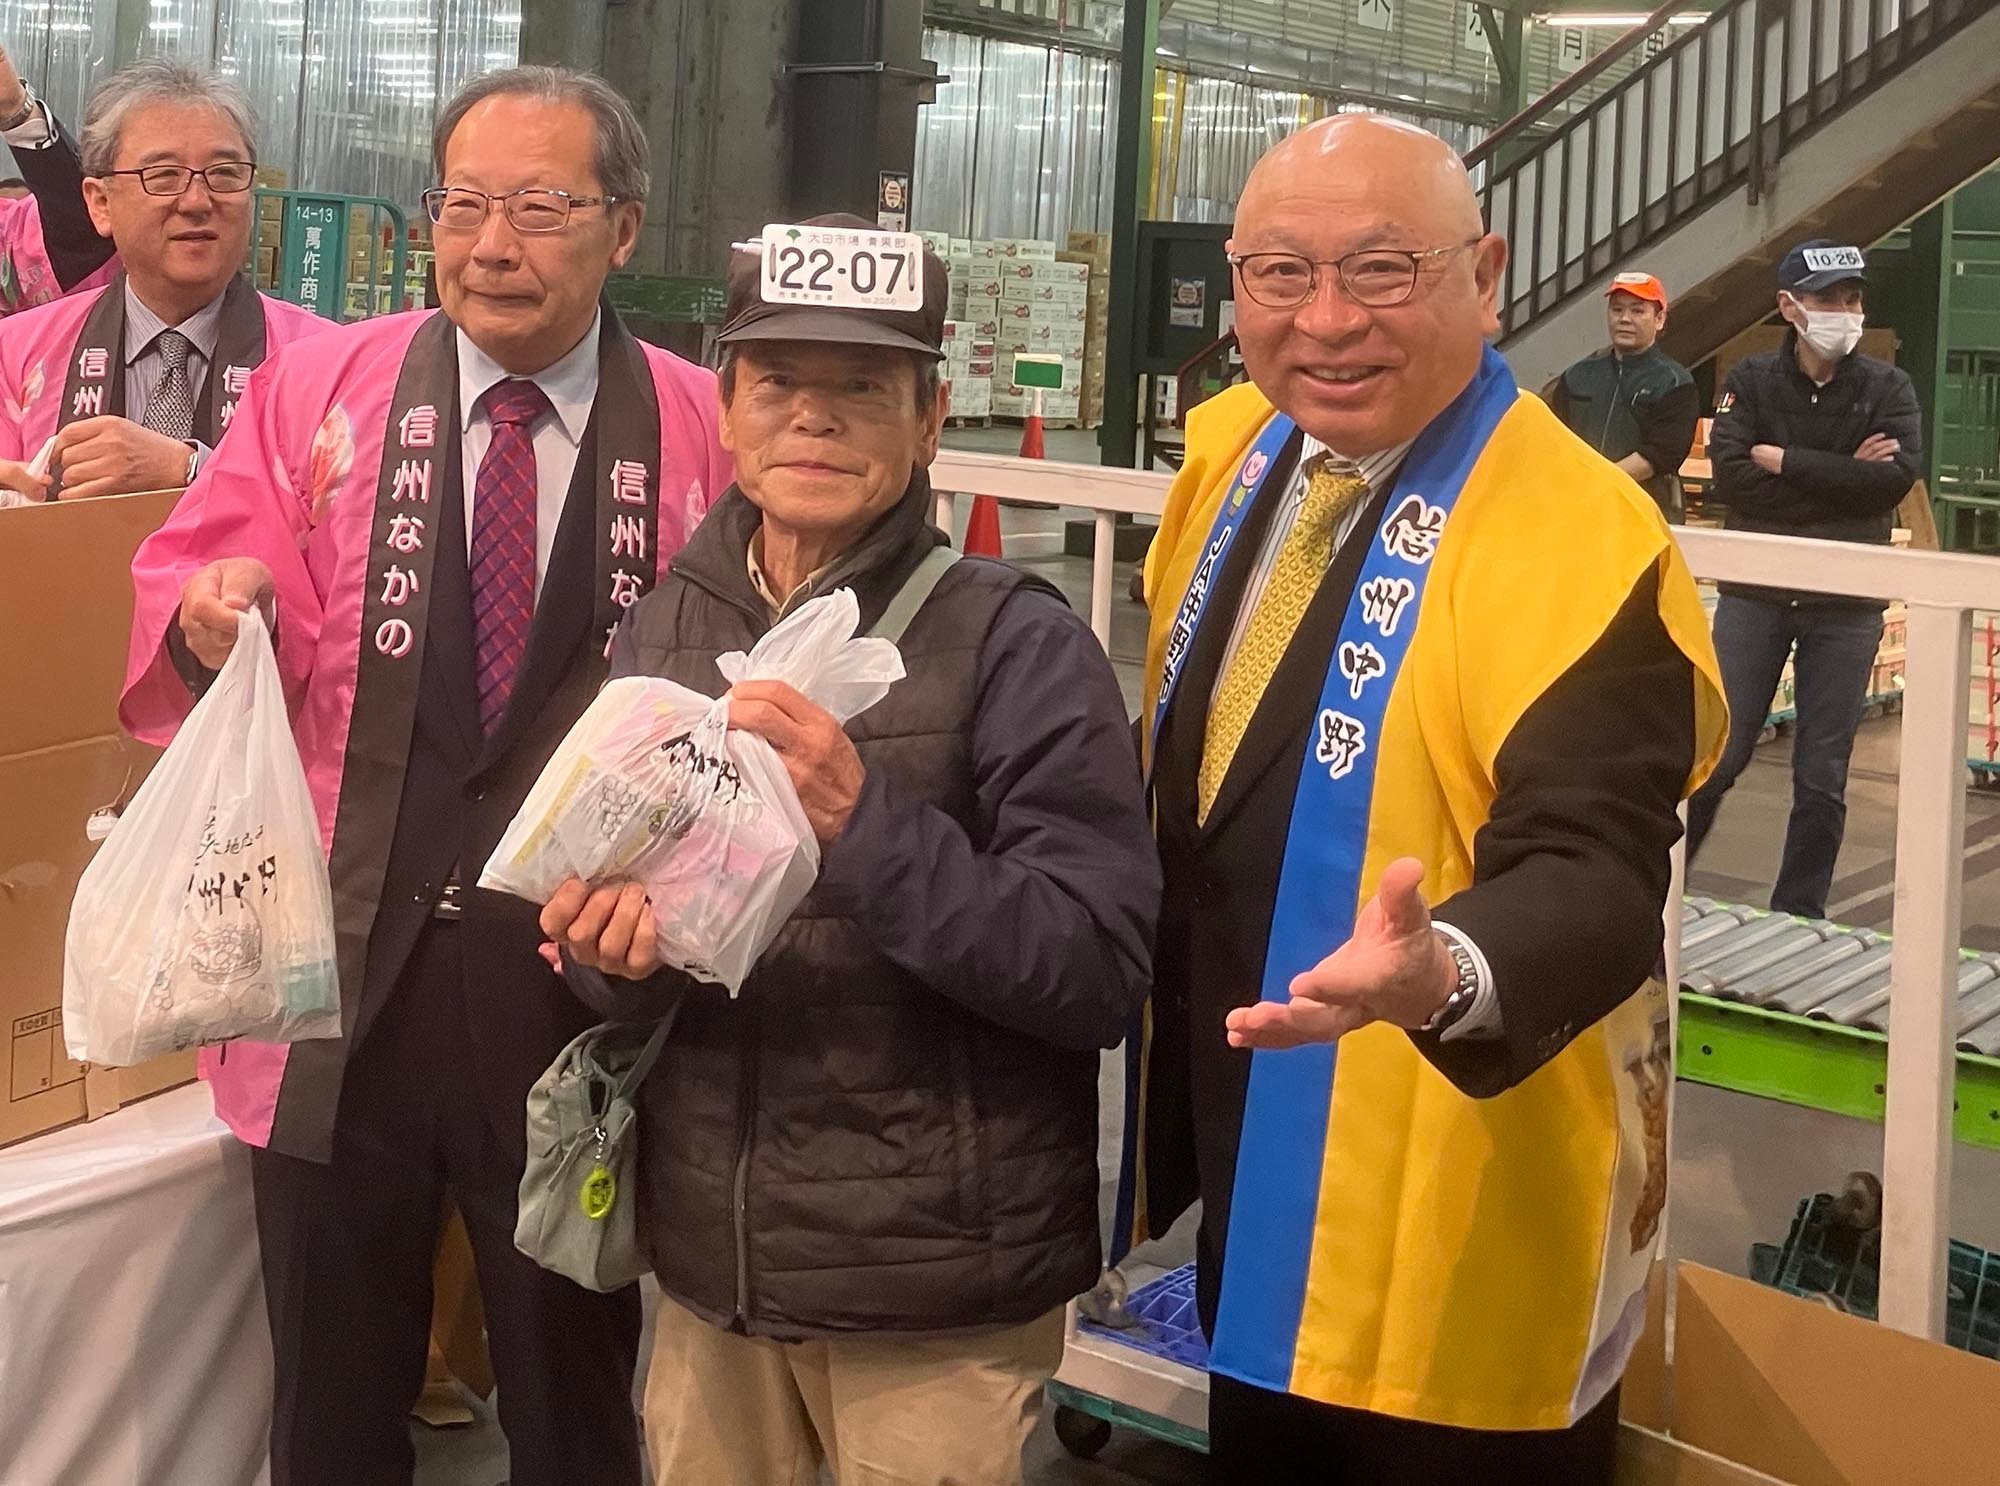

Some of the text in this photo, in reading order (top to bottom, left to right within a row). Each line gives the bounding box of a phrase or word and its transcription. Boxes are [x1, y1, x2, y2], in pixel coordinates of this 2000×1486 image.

[296, 206, 333, 223] 14-13
[779, 246, 906, 295] 22-07
[73, 347, 109, 417] 信州
[375, 404, 440, 659] 信州なかの
[1316, 494, 1448, 779] 信州中野
